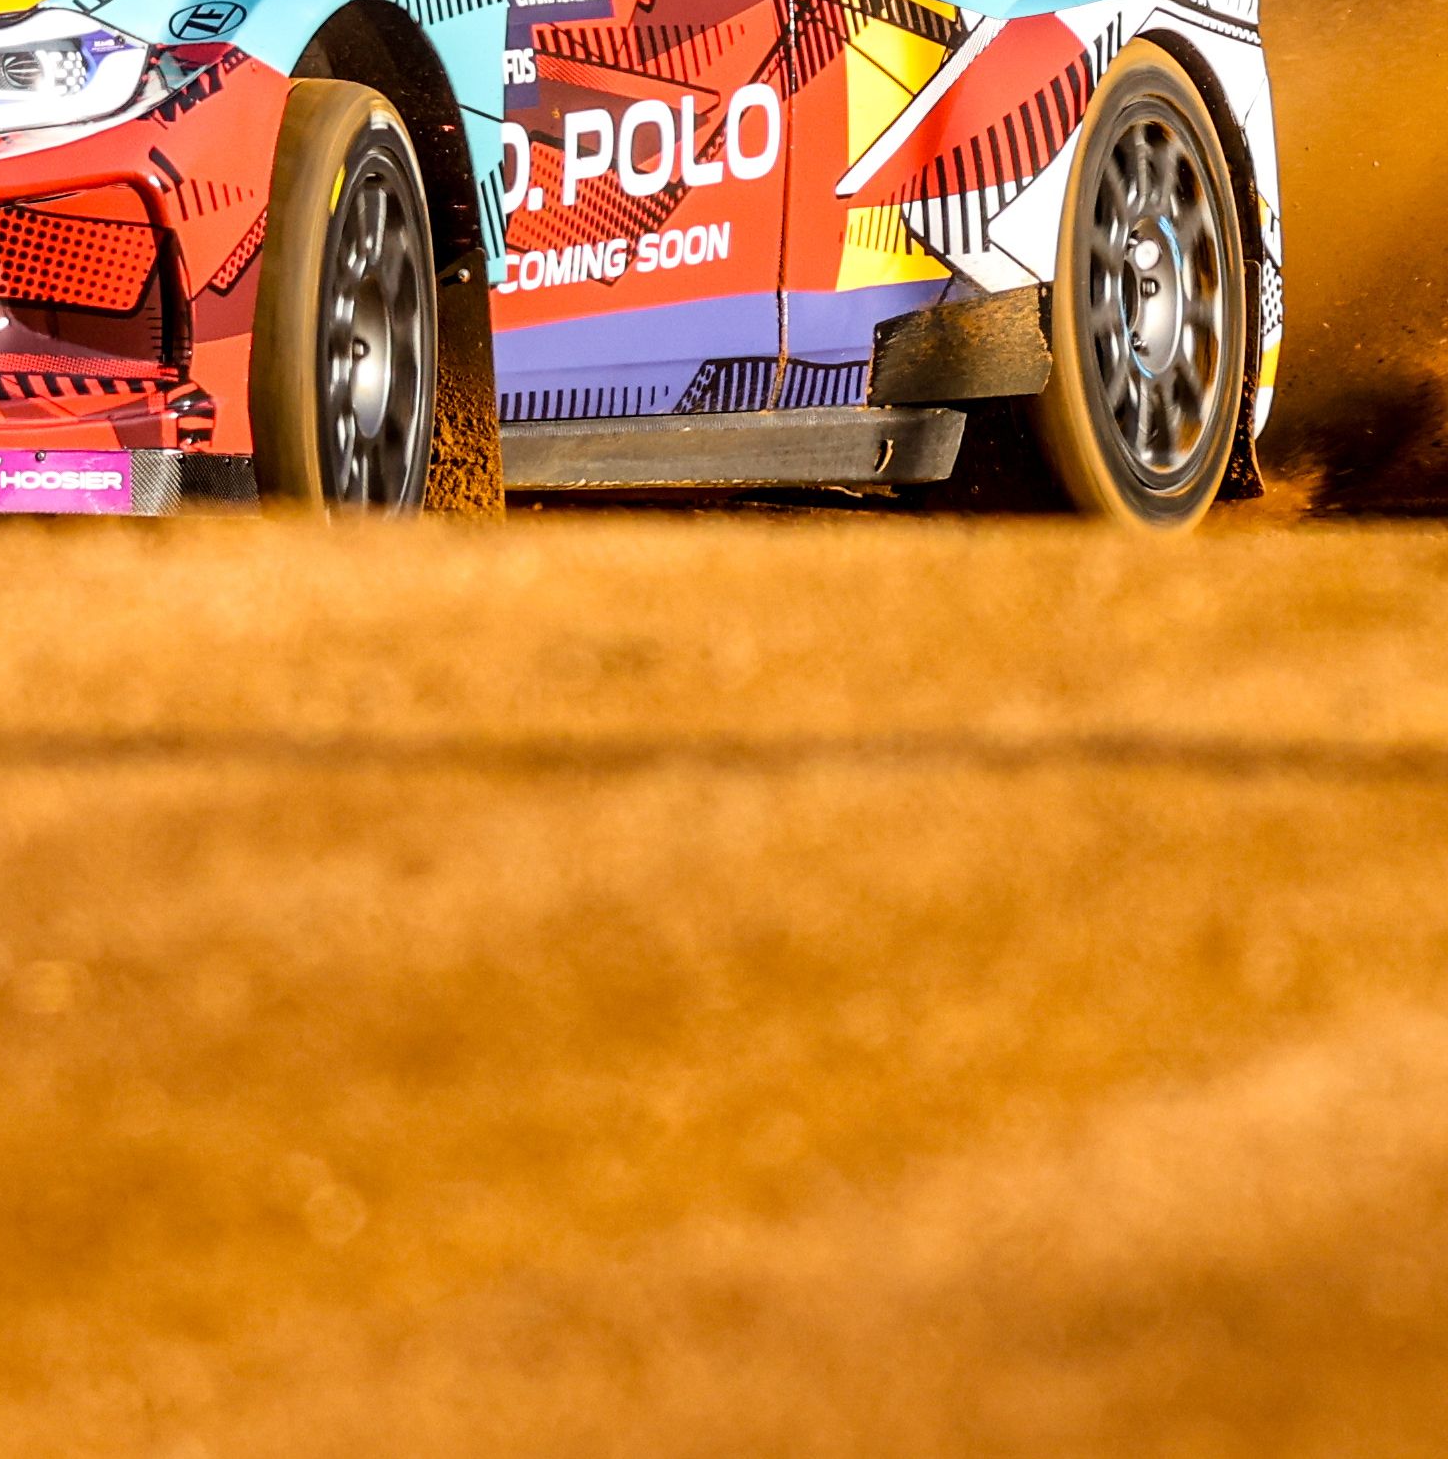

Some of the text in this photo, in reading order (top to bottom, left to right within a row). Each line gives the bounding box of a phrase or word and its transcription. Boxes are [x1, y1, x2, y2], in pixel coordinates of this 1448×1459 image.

[174, 3, 243, 39] ZF
[562, 83, 781, 207] POLO
[497, 222, 731, 294] COMING SOON
[0, 471, 123, 490] HOOSIER
